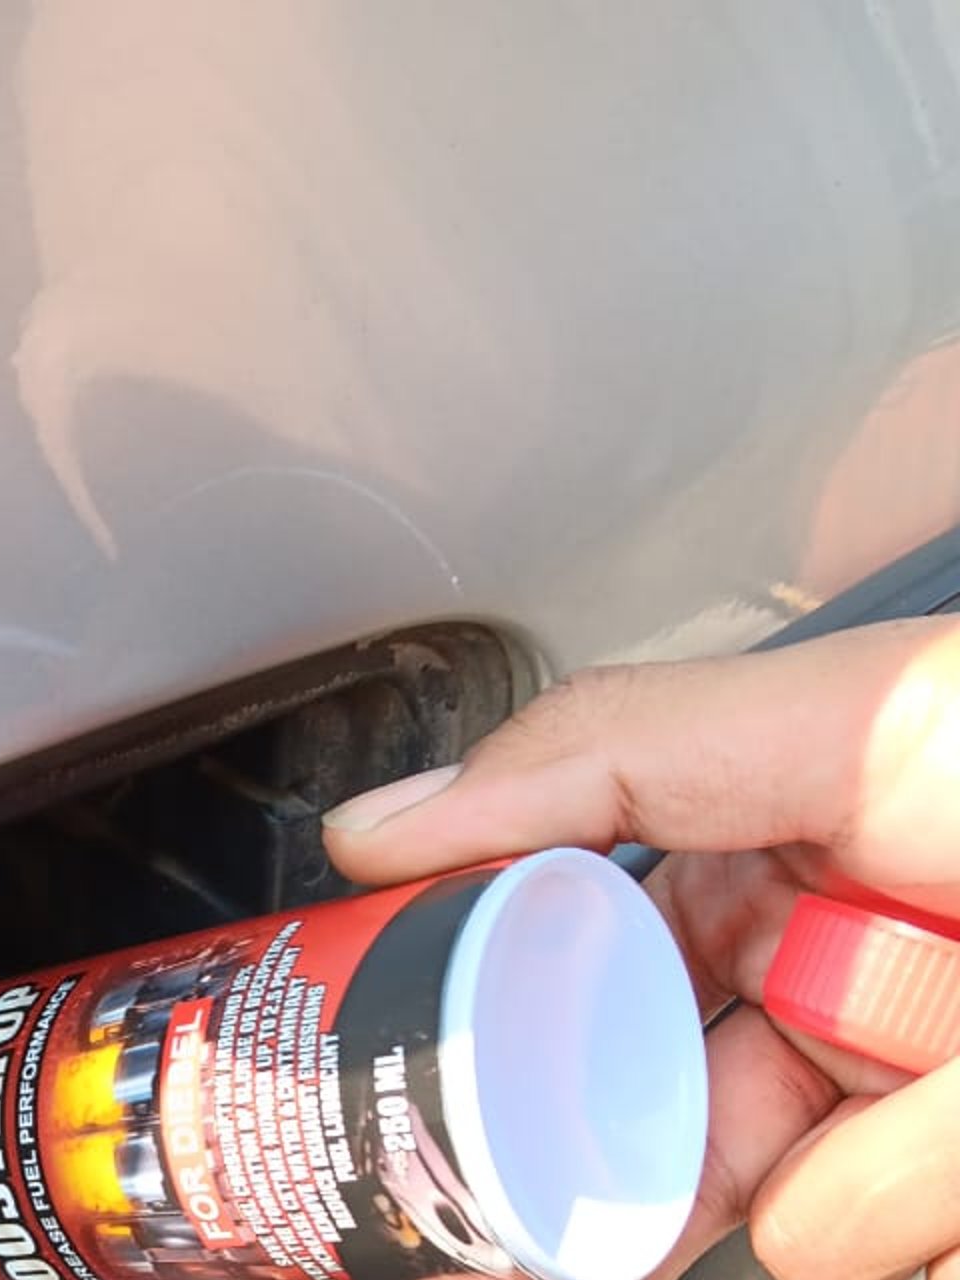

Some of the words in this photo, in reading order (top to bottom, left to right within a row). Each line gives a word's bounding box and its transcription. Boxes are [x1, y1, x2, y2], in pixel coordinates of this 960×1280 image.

[270, 946, 302, 989] POINT
[215, 993, 243, 1071] ARROUND
[239, 1009, 259, 1035] OR
[257, 1016, 278, 1043] TO
[275, 977, 308, 1100] CONTAMINANT
[297, 984, 326, 1080] EMISSIONS
[18, 979, 77, 1144] PERFORMANCE
[167, 1009, 204, 1157] DIESEL
[254, 1043, 274, 1070] UP
[319, 1033, 347, 1137] LUBRICANT
[373, 1045, 407, 1093] ML
[214, 1073, 254, 1197] CONSUMPTION
[254, 1071, 282, 1147] NUMBER
[376, 1095, 417, 1153] 250
[22, 1150, 50, 1211] FUEL
[240, 1132, 290, 1226] FORMATION
[280, 1118, 311, 1182] WATER
[327, 1137, 358, 1182] FUEL
[178, 1166, 234, 1241] FOR
[239, 1198, 273, 1234] FUEL
[295, 1183, 342, 1243] REMOVE
[313, 1169, 358, 1229] REDUCE
[257, 1235, 294, 1267] SAVE
[273, 1226, 302, 1255] THE
[288, 1212, 344, 1273] INCREASE
